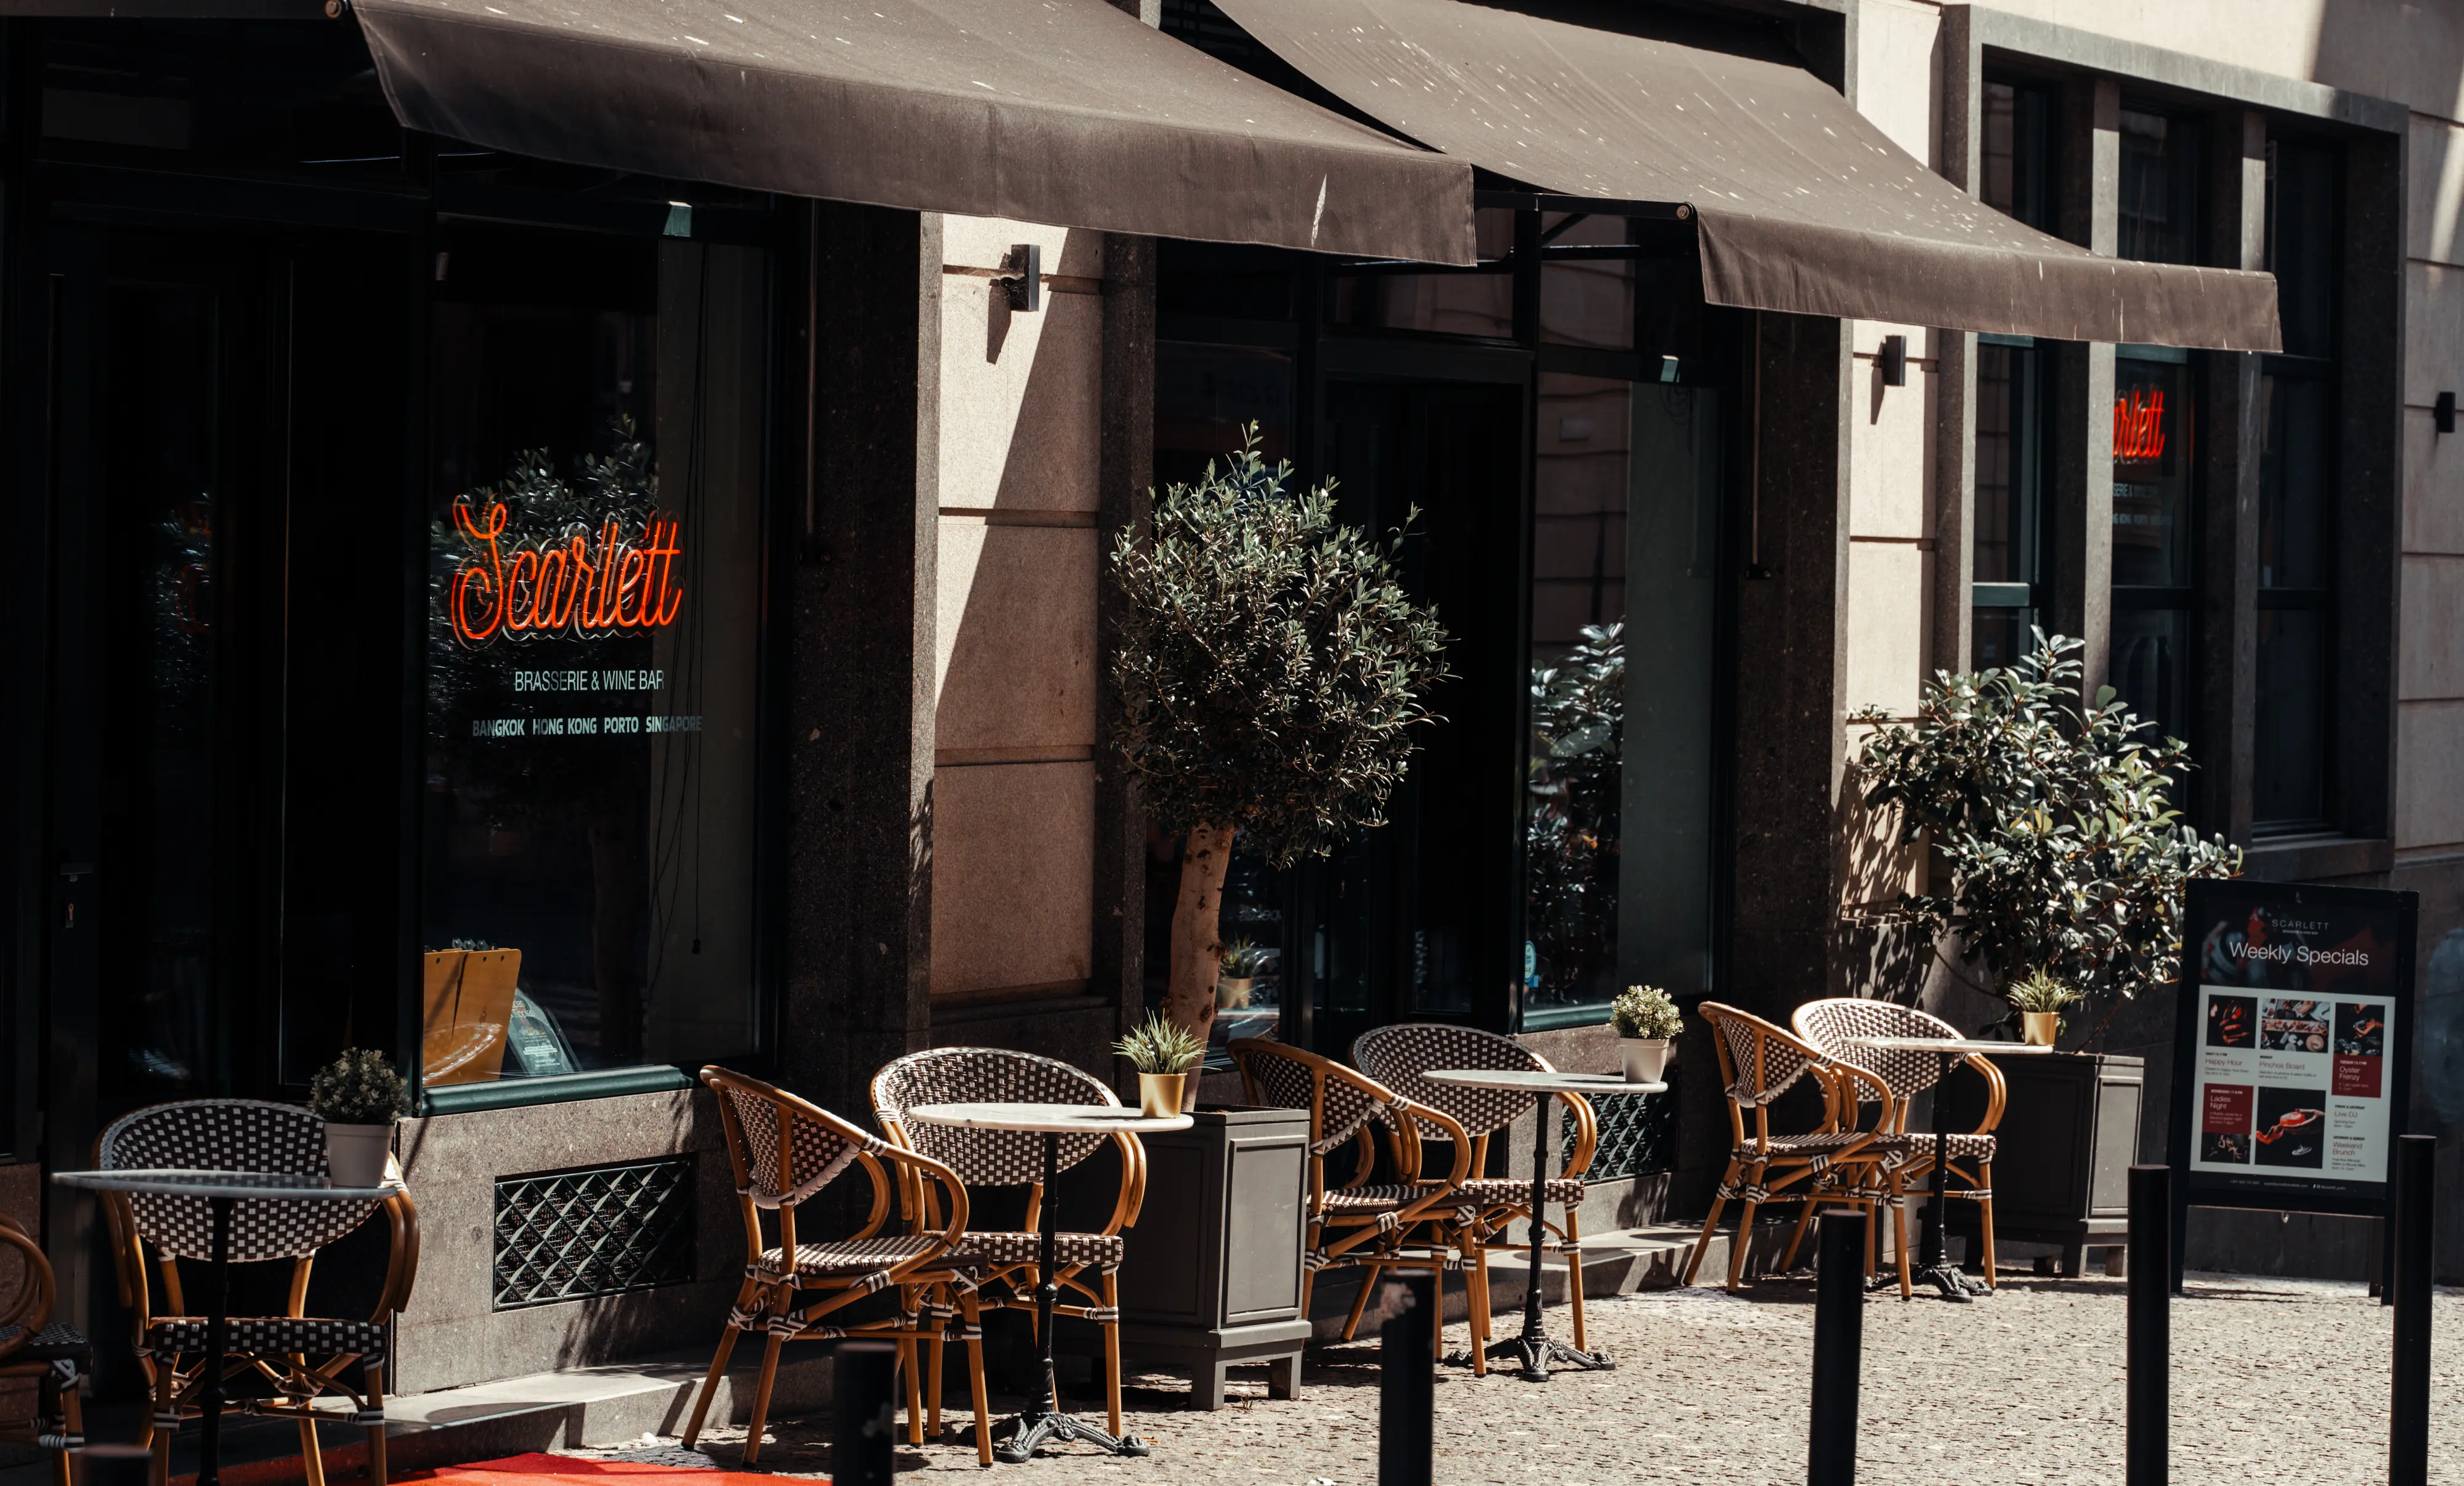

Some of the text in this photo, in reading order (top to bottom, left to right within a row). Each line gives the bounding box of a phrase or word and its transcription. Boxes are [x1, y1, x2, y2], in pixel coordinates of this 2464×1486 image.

[459, 503, 683, 639] Scarlett
[515, 670, 665, 692] BRASSERIE & WINE BAR
[472, 716, 702, 737] BANGKOK HONG KONG PORTO SINGAPORE
[2272, 919, 2329, 931] SCARLETT
[2230, 942, 2369, 966] Weekly Specials
[2205, 1057, 2225, 1065] Happy
[2340, 1066, 2361, 1074] Oyster
[2339, 1073, 2360, 1081] Frenzy
[2210, 1102, 2227, 1110] Night
